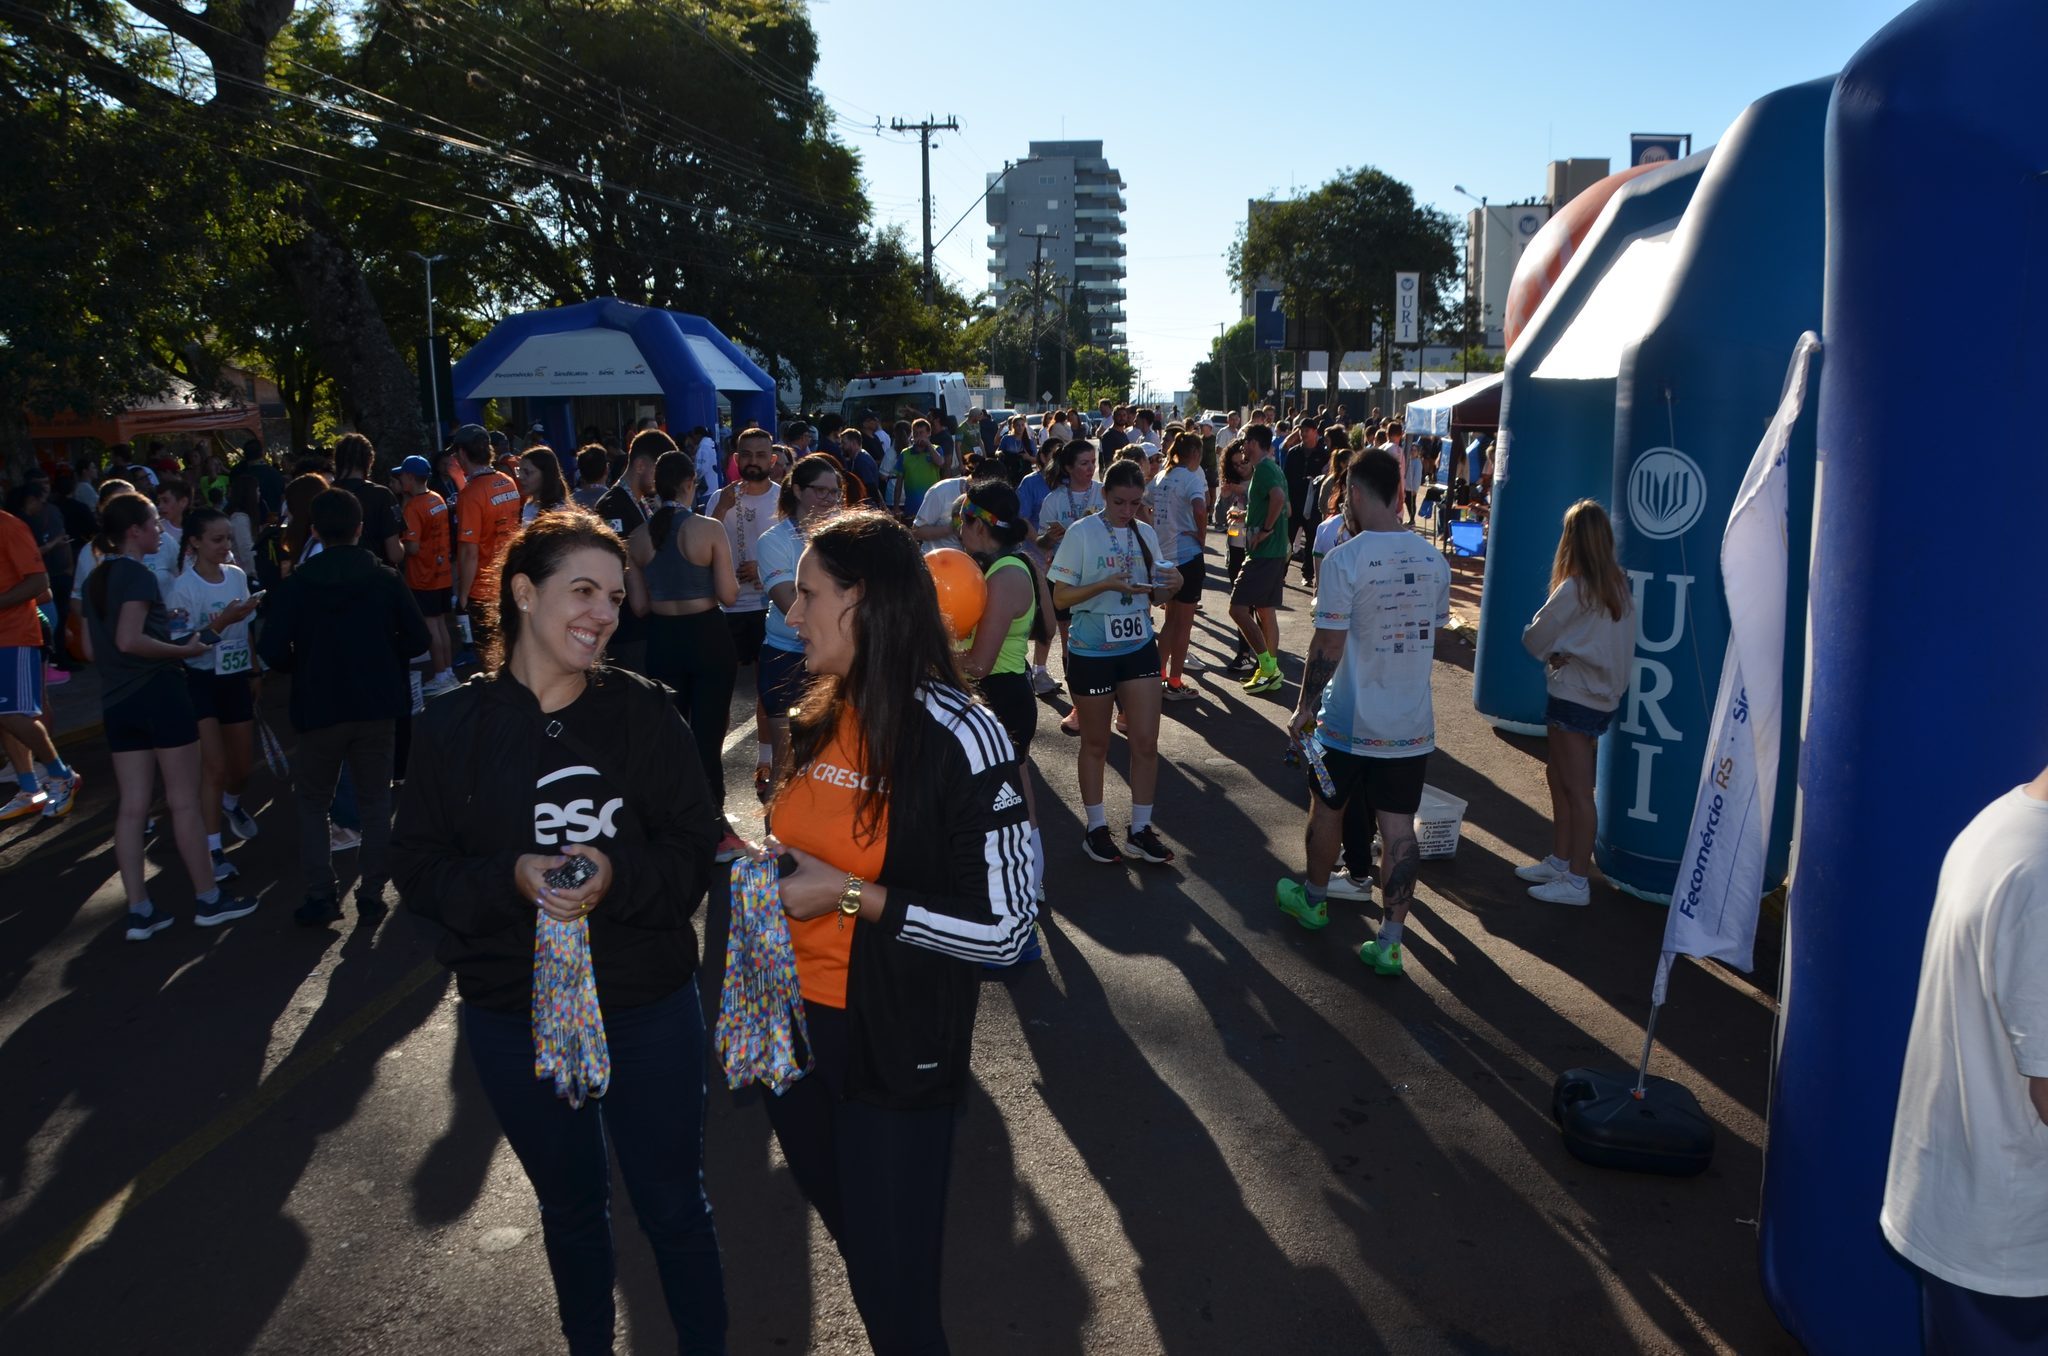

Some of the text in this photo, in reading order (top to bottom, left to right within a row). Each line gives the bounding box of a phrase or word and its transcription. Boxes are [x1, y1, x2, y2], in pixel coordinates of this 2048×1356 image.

[1401, 295, 1413, 338] URI
[1111, 616, 1143, 639] 696
[222, 649, 249, 671] 552
[1089, 685, 1112, 695] RUN
[1619, 569, 1695, 823] URI
[992, 794, 1023, 813] adidas
[1679, 794, 1724, 920] Fecomércio
[1714, 757, 1734, 790] RS
